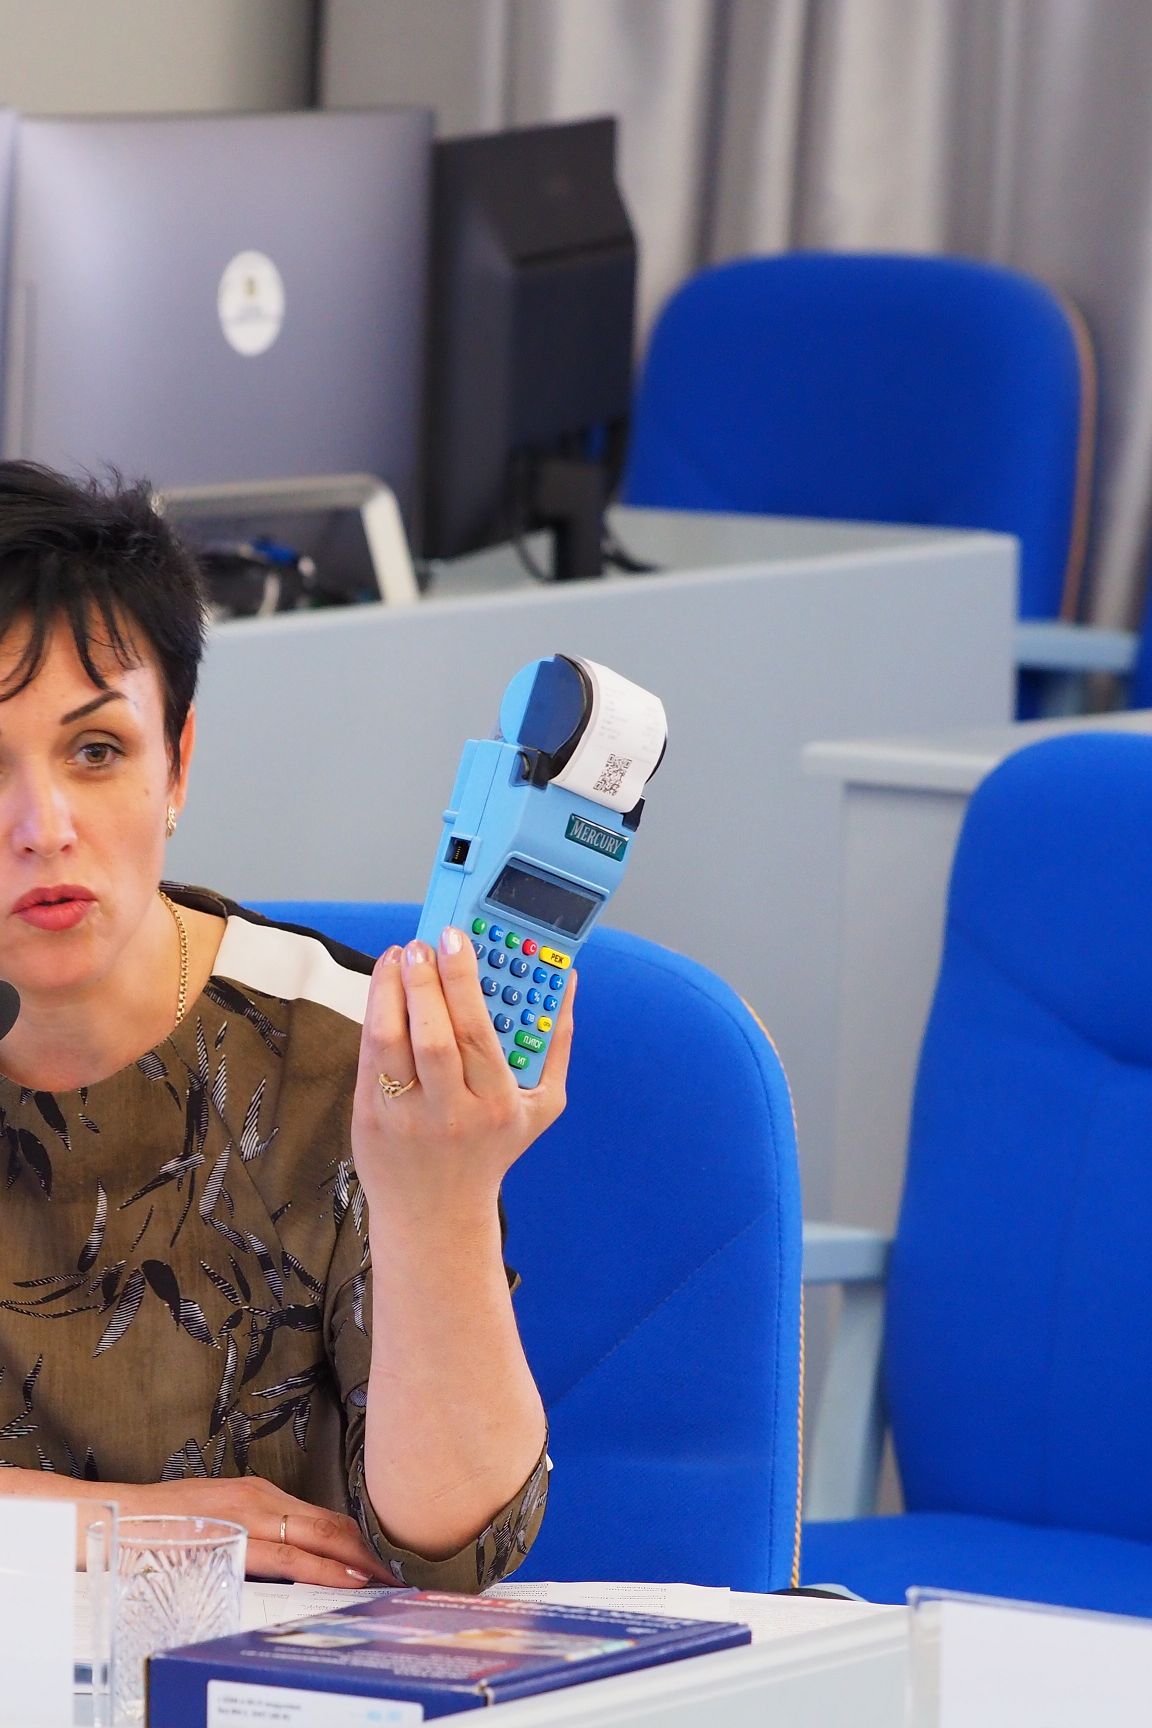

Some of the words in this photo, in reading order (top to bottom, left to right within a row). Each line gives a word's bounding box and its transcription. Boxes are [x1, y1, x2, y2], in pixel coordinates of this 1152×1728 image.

[569, 820, 623, 855] MERCURY
[476, 944, 484, 955] 7
[498, 953, 505, 964] 8
[520, 962, 527, 973] 9
[490, 982, 497, 992] 5
[511, 991, 518, 1001] 6
[503, 1018, 510, 1029] 3
